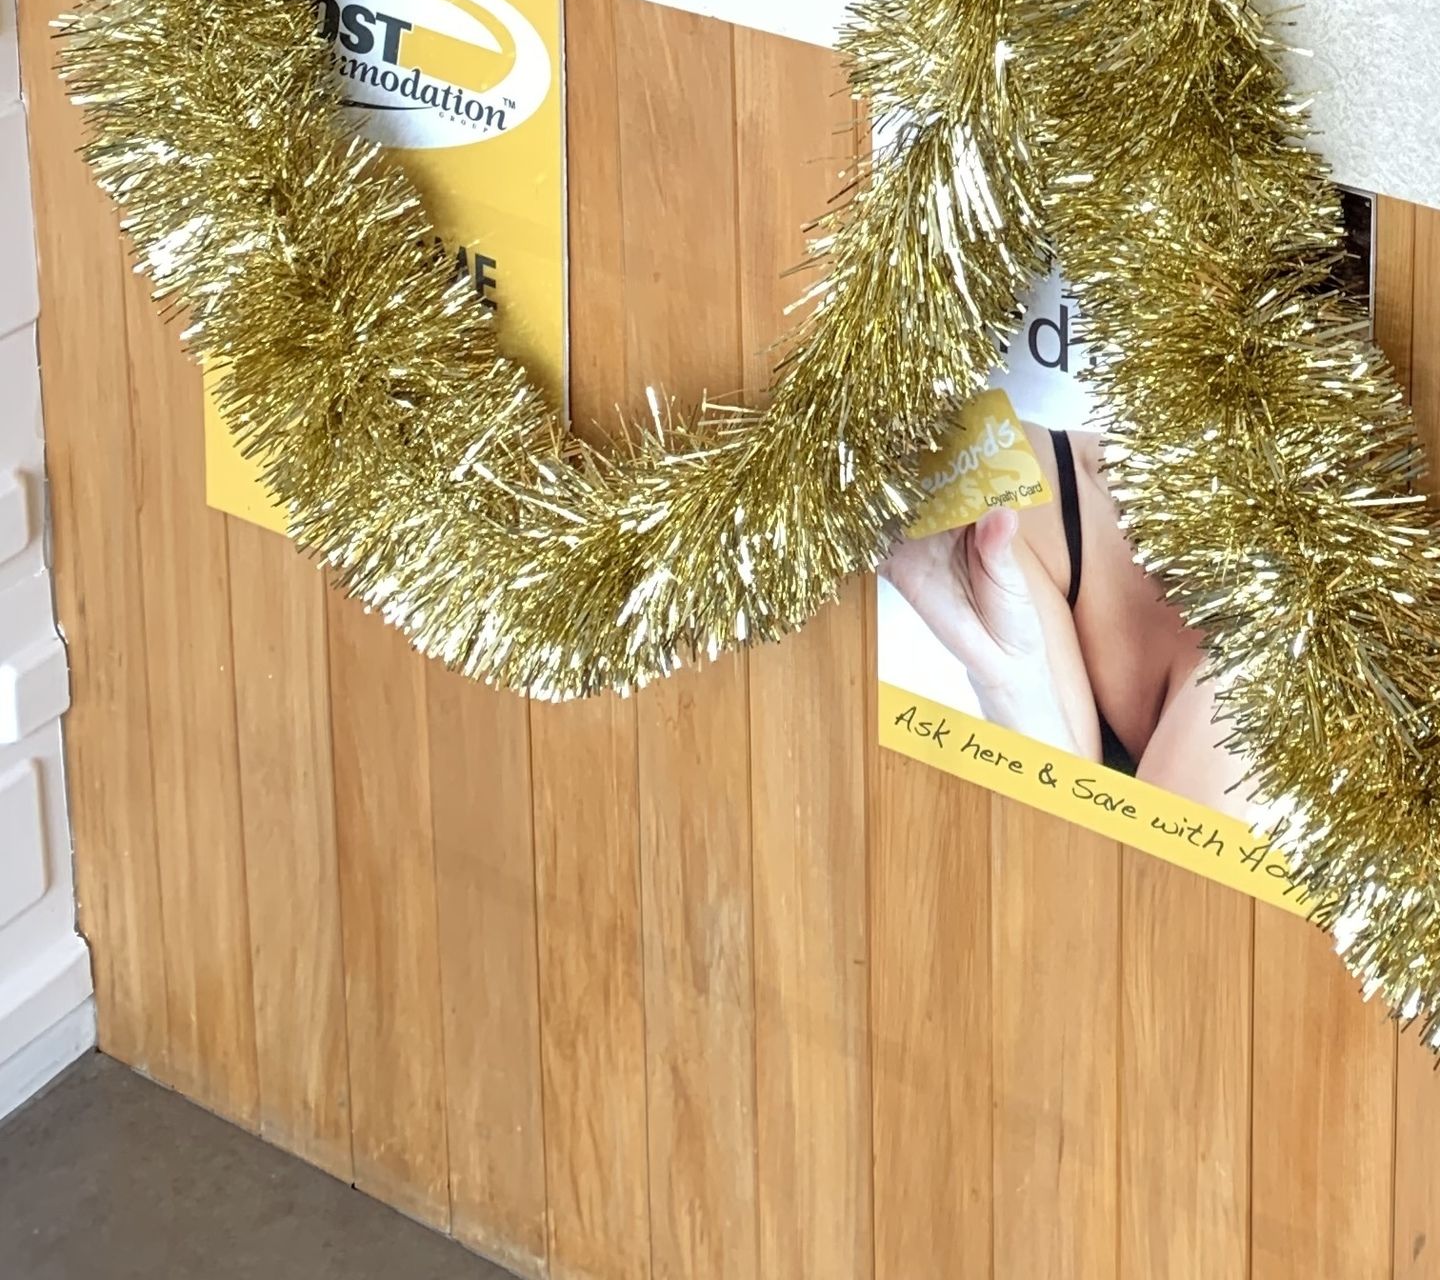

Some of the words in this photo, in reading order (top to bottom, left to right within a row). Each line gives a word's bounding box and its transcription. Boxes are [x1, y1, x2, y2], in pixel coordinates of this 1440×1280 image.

[439, 111, 489, 133] GROUP
[921, 415, 1017, 493] ewards
[984, 486, 1018, 507] Loyalty
[1018, 483, 1044, 500] Card
[894, 706, 951, 749] Ask
[960, 733, 1024, 775] here
[1038, 762, 1058, 789] &
[1072, 778, 1138, 820] Save
[1150, 817, 1225, 857] with
